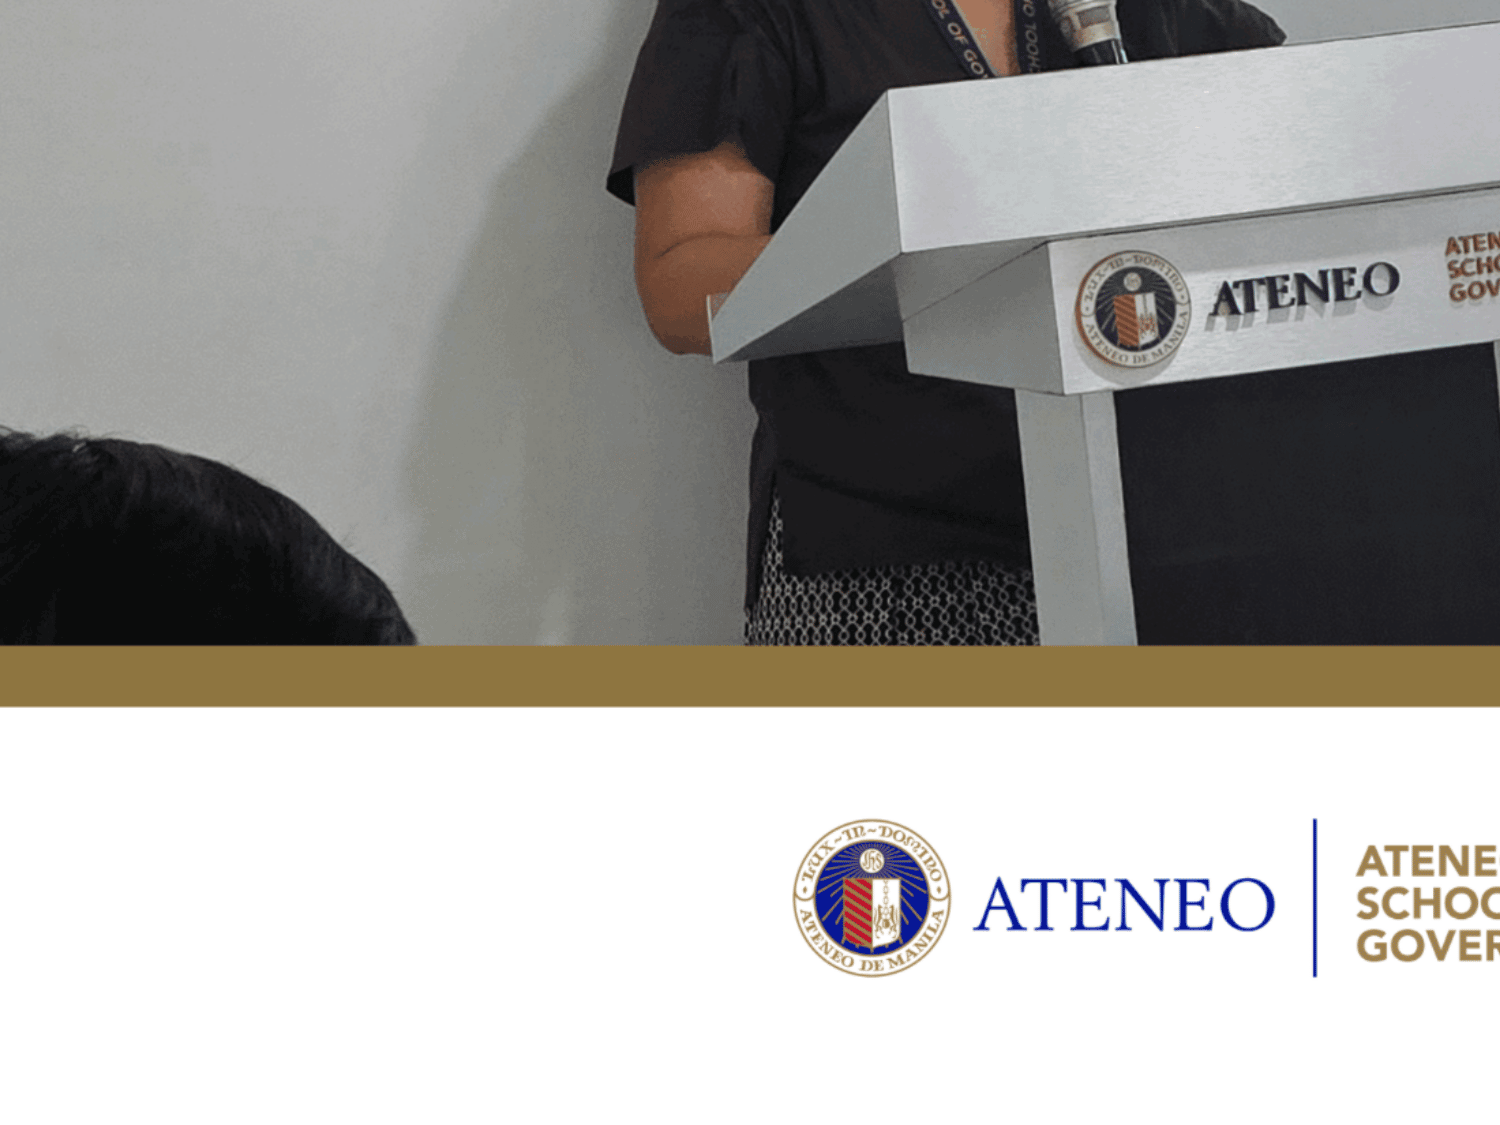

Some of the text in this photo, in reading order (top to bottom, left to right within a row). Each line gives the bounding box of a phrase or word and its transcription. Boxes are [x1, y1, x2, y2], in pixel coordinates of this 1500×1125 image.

[948, 22, 970, 46] OF
[964, 49, 988, 79] GO
[1208, 261, 1400, 316] ATENEO
[1086, 323, 1129, 362] ATENEO
[1151, 311, 1188, 359] MANILA
